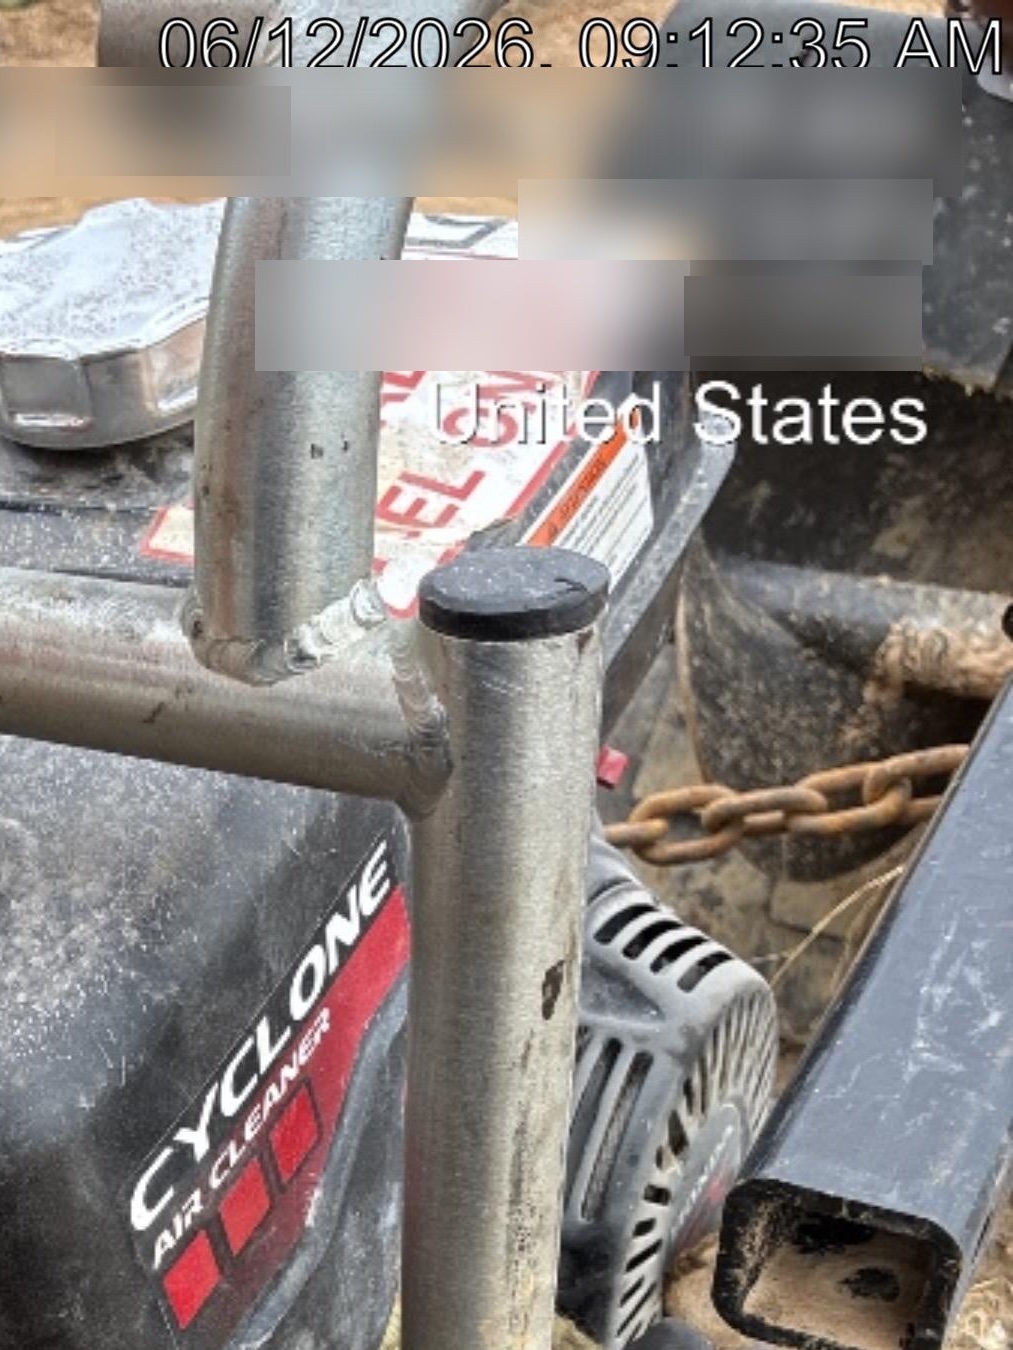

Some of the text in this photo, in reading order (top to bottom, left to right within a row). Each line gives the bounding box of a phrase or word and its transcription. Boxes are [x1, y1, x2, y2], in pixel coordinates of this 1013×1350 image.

[129, 839, 391, 1232] CYCLONE
[152, 1007, 332, 1271] AIR CLEANER
